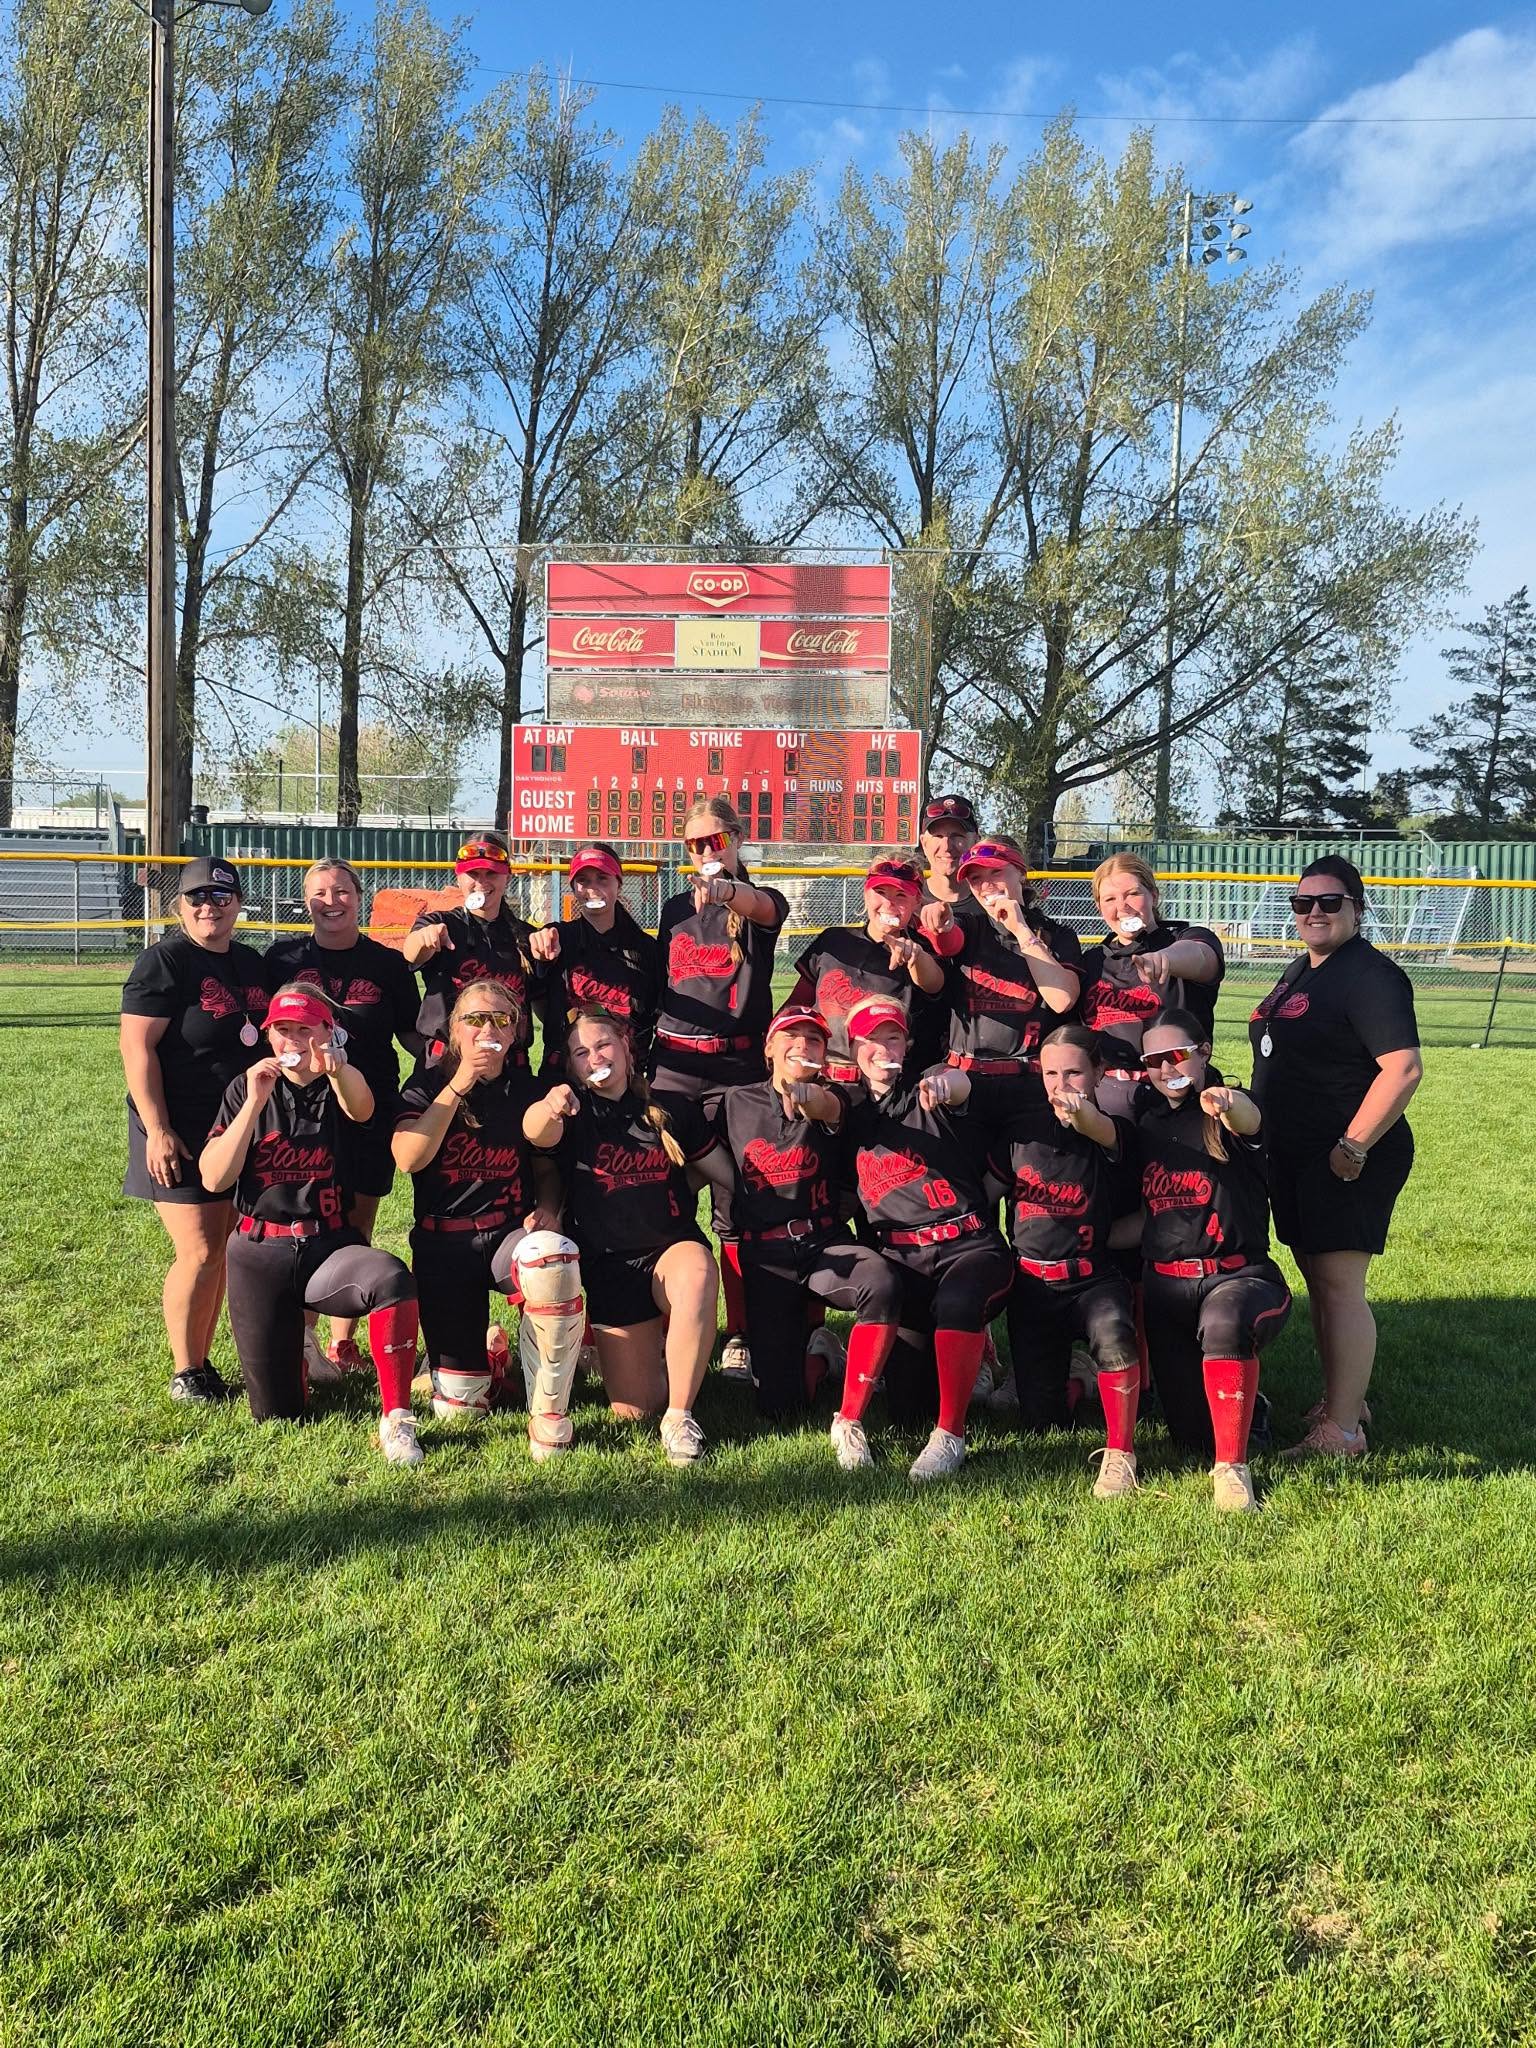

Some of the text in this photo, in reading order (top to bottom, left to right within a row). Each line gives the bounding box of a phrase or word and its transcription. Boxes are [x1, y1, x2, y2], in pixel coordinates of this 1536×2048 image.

[693, 578, 743, 592] CO-OP
[710, 632, 725, 640] Bob
[523, 729, 574, 744] AT BAT
[621, 730, 658, 746] BALL
[689, 732, 743, 747] STRIKE
[776, 732, 807, 748] OUT
[871, 734, 896, 750] H/E
[592, 777, 917, 794] 1 2 3 4 5 6 7 8 9 10 RUNS HITS ERR
[520, 790, 576, 809] GUEST
[521, 815, 575, 833] HOME
[728, 983, 738, 1009] 1
[255, 1130, 334, 1169] Storm
[442, 1131, 520, 1169] Storm
[595, 1143, 671, 1172] Storm
[1015, 1165, 1088, 1206] Storm
[1142, 1161, 1212, 1197] Storm
[810, 1179, 830, 1211] 14
[922, 1178, 957, 1210] 16
[1077, 1224, 1095, 1251] 3
